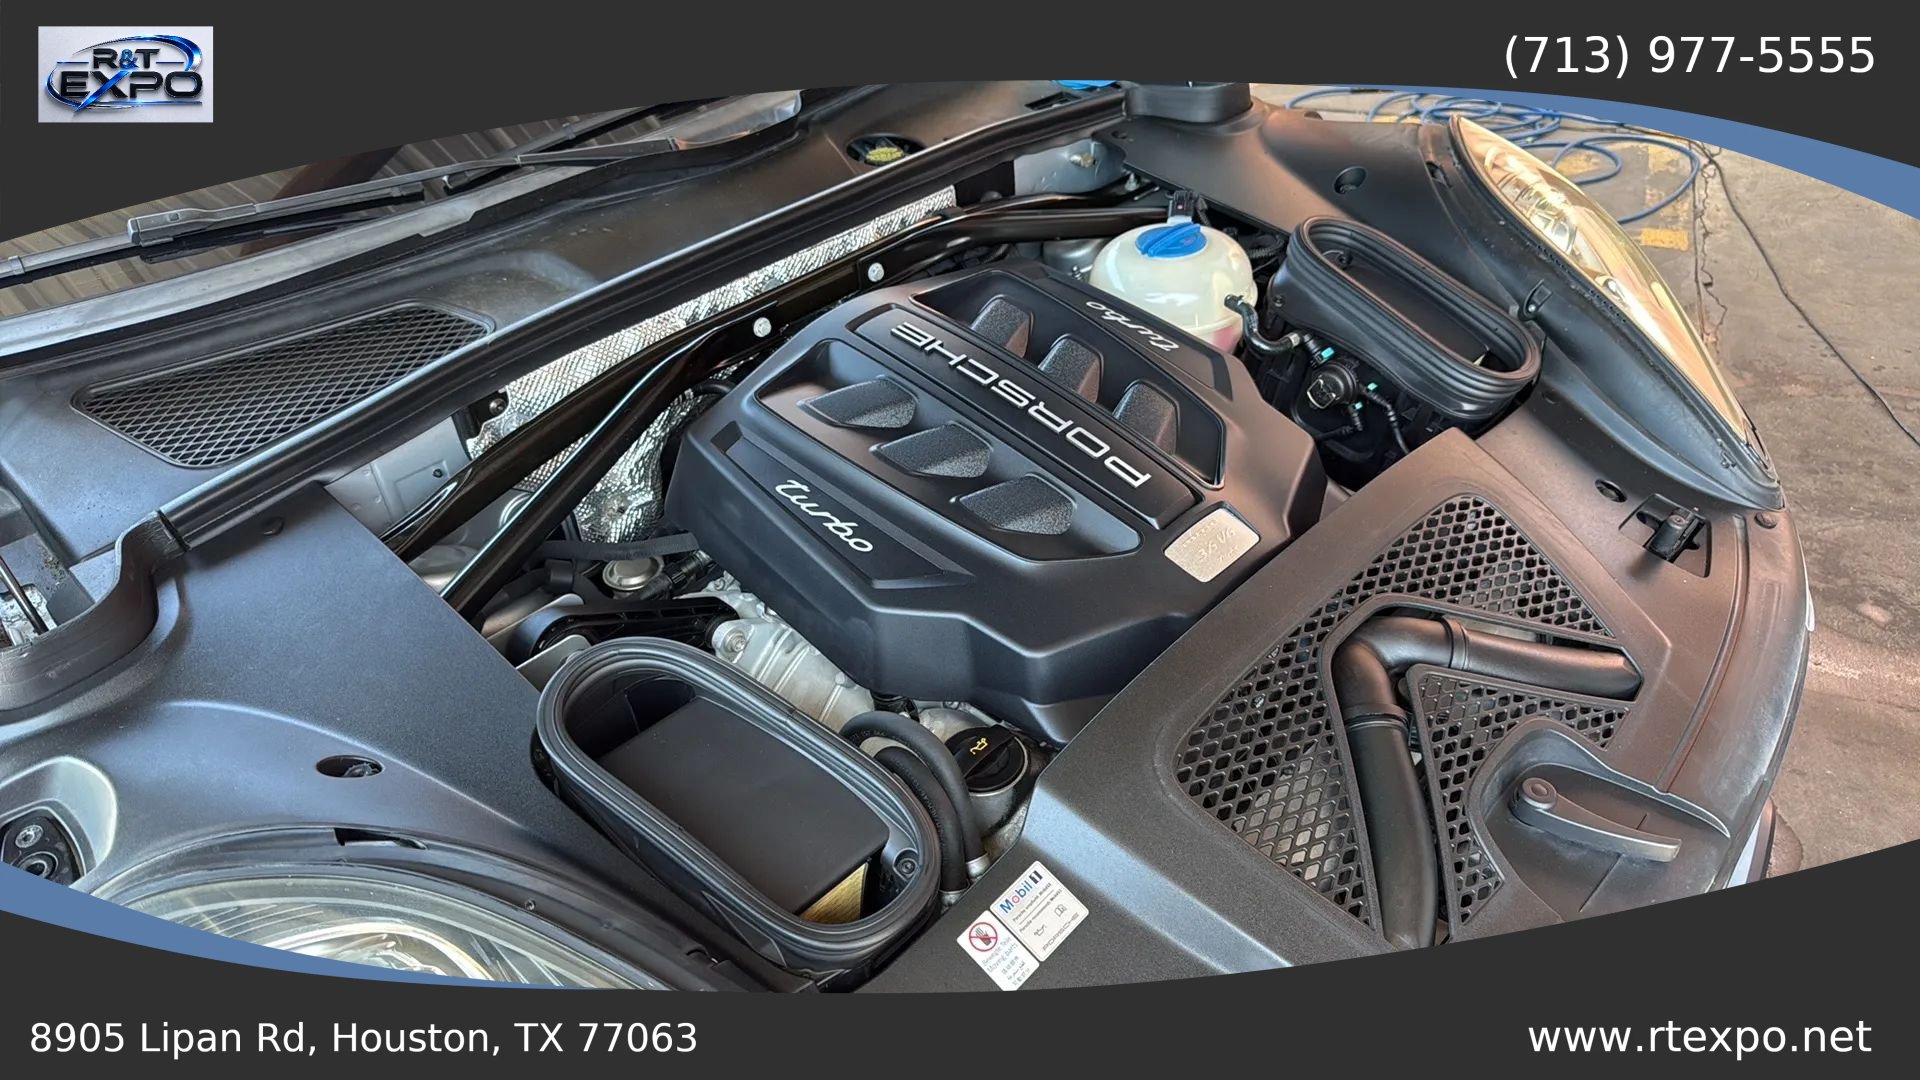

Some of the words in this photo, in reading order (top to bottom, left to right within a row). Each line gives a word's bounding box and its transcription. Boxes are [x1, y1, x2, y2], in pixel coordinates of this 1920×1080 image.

[890, 321, 1152, 488] PORSCHE
[1000, 880, 1033, 913] Mobil
[1029, 870, 1043, 884] 1
[1042, 912, 1079, 951] PORSCHE
